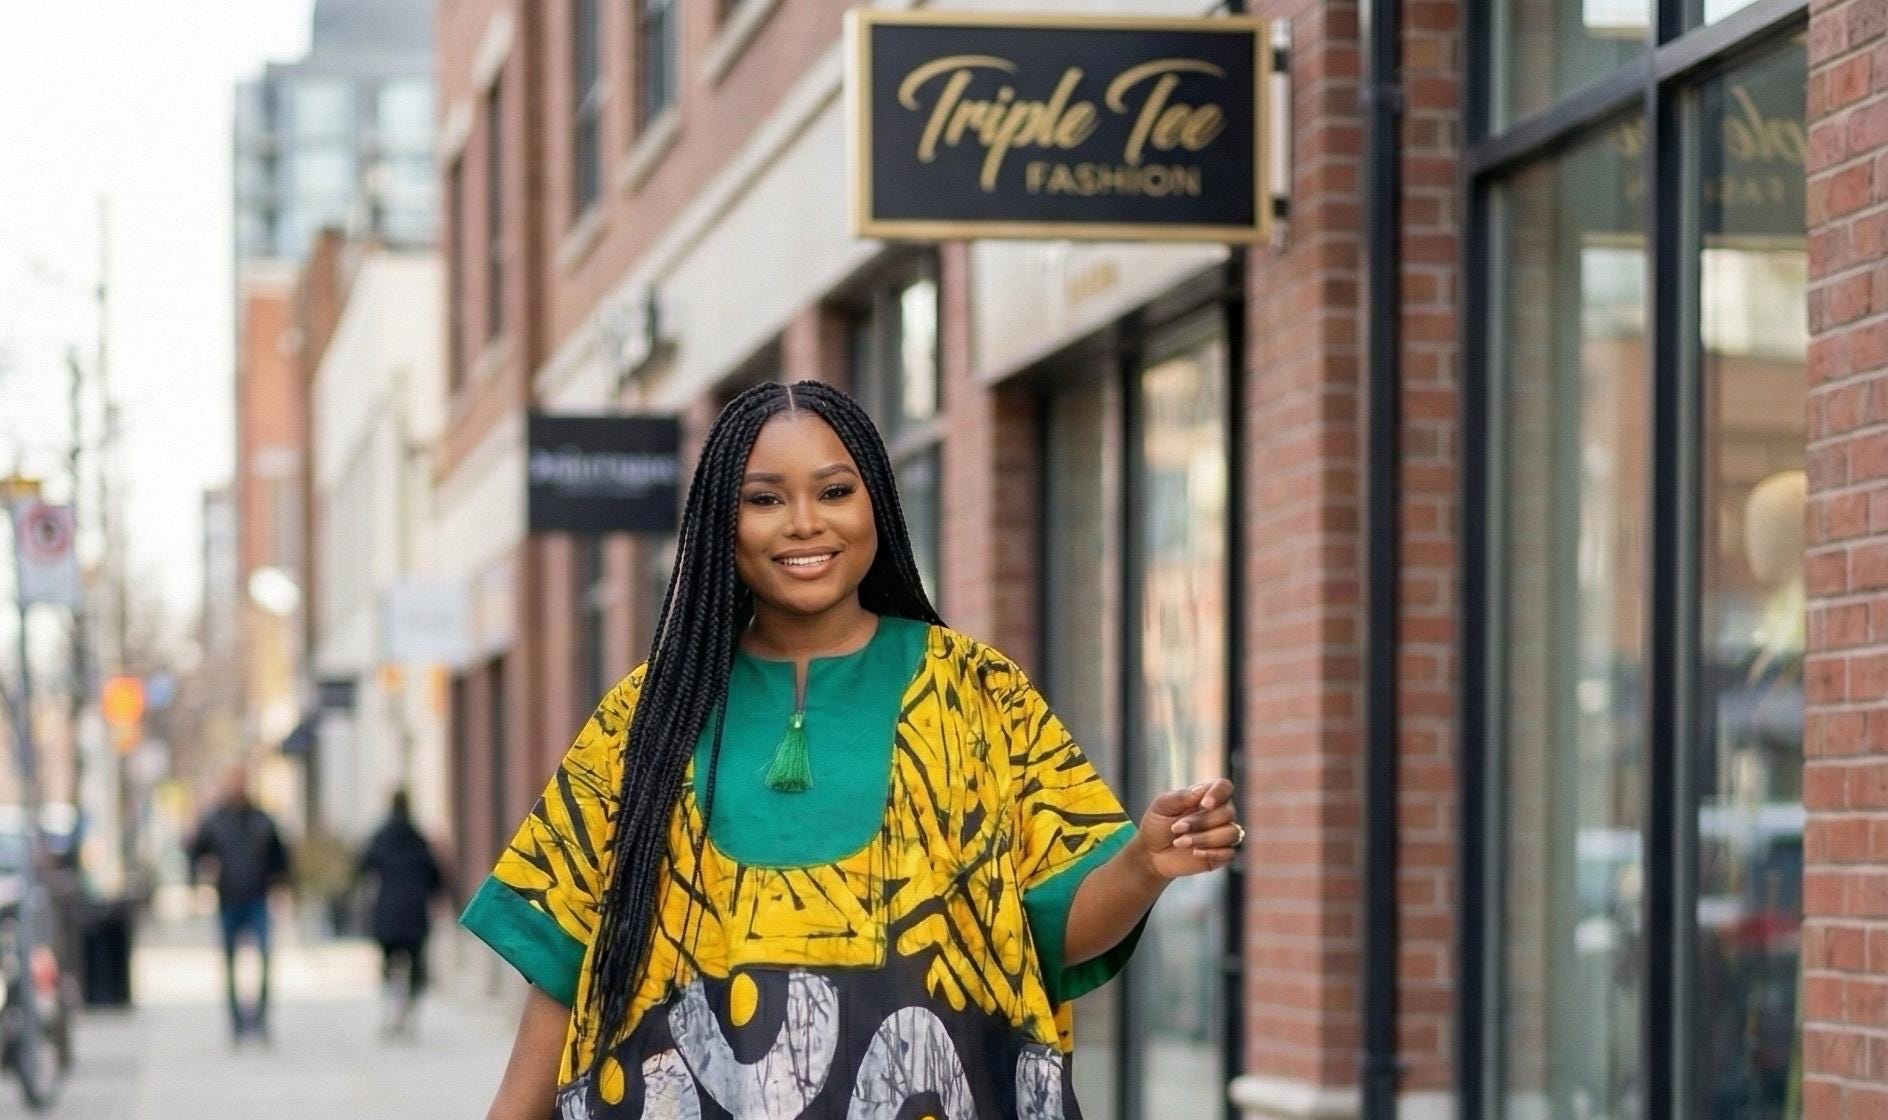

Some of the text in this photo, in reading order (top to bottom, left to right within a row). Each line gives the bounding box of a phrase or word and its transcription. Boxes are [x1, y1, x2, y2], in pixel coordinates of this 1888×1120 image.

[898, 54, 1227, 194] Triple Tee
[1025, 162, 1200, 196] FASHION
